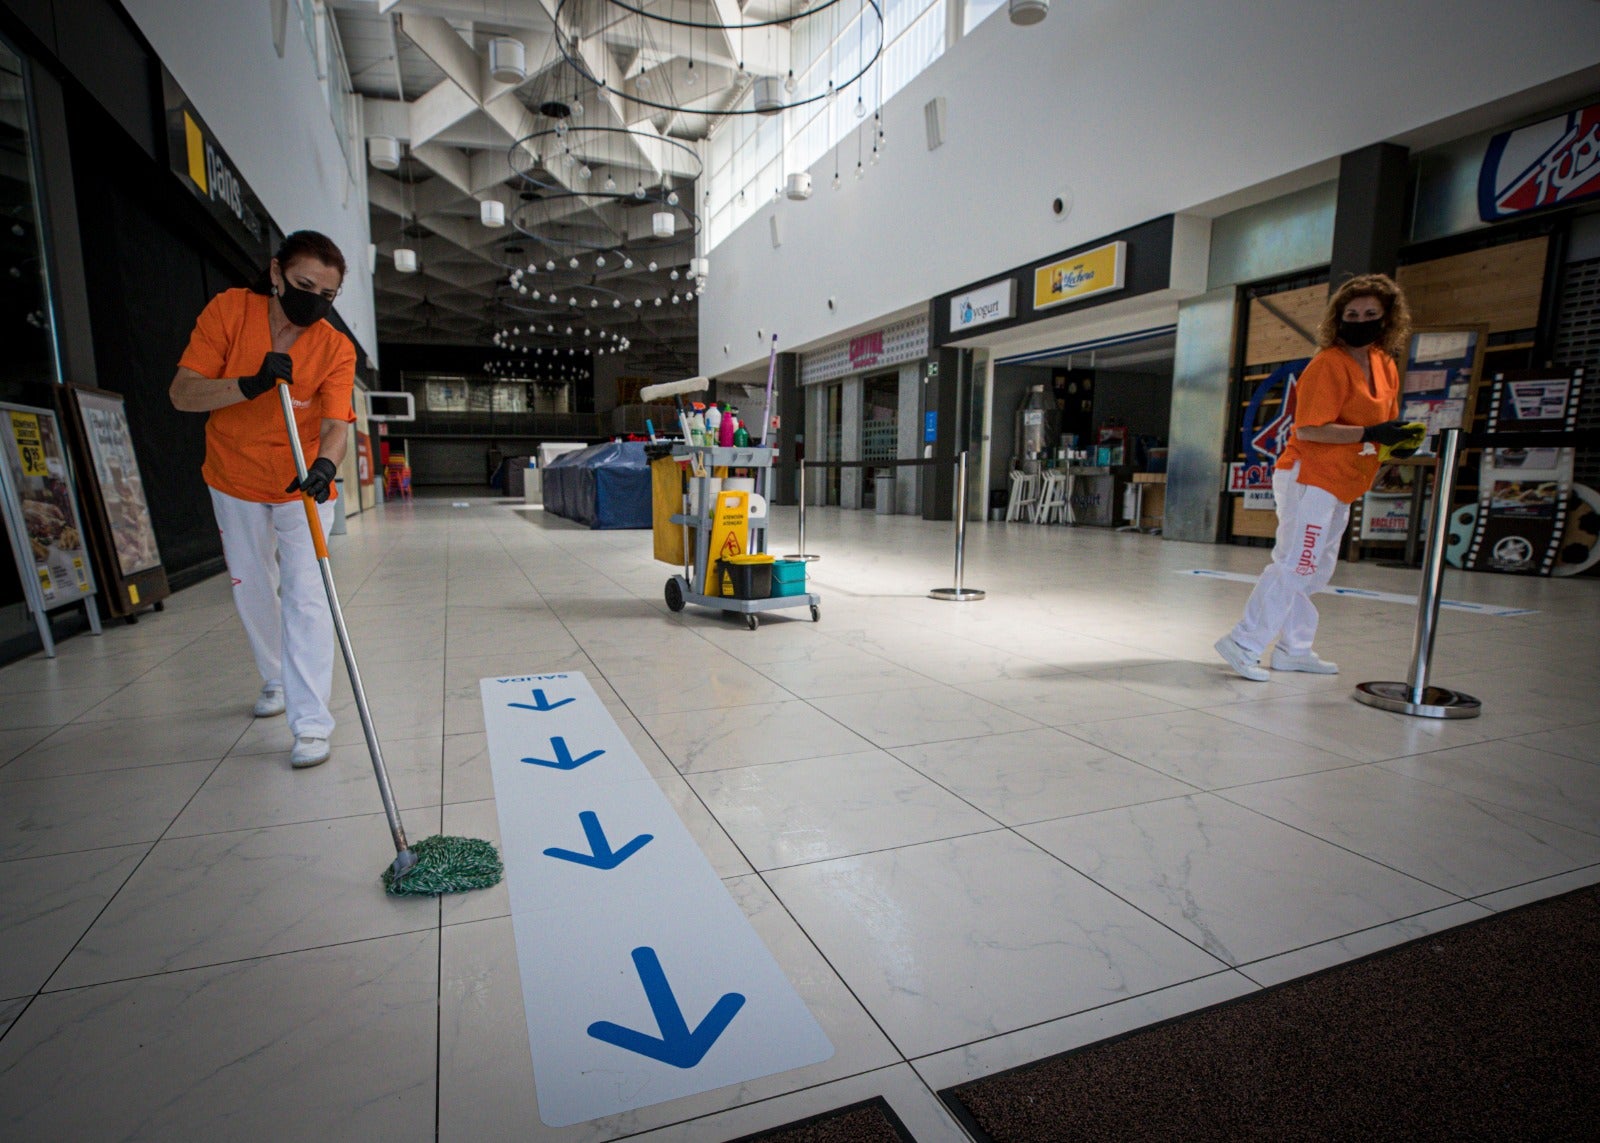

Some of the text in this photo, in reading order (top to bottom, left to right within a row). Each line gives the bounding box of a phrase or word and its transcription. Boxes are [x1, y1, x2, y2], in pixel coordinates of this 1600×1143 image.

[206, 141, 243, 220] pans
[973, 301, 999, 321] yogurt
[496, 674, 569, 684] SALIDA
